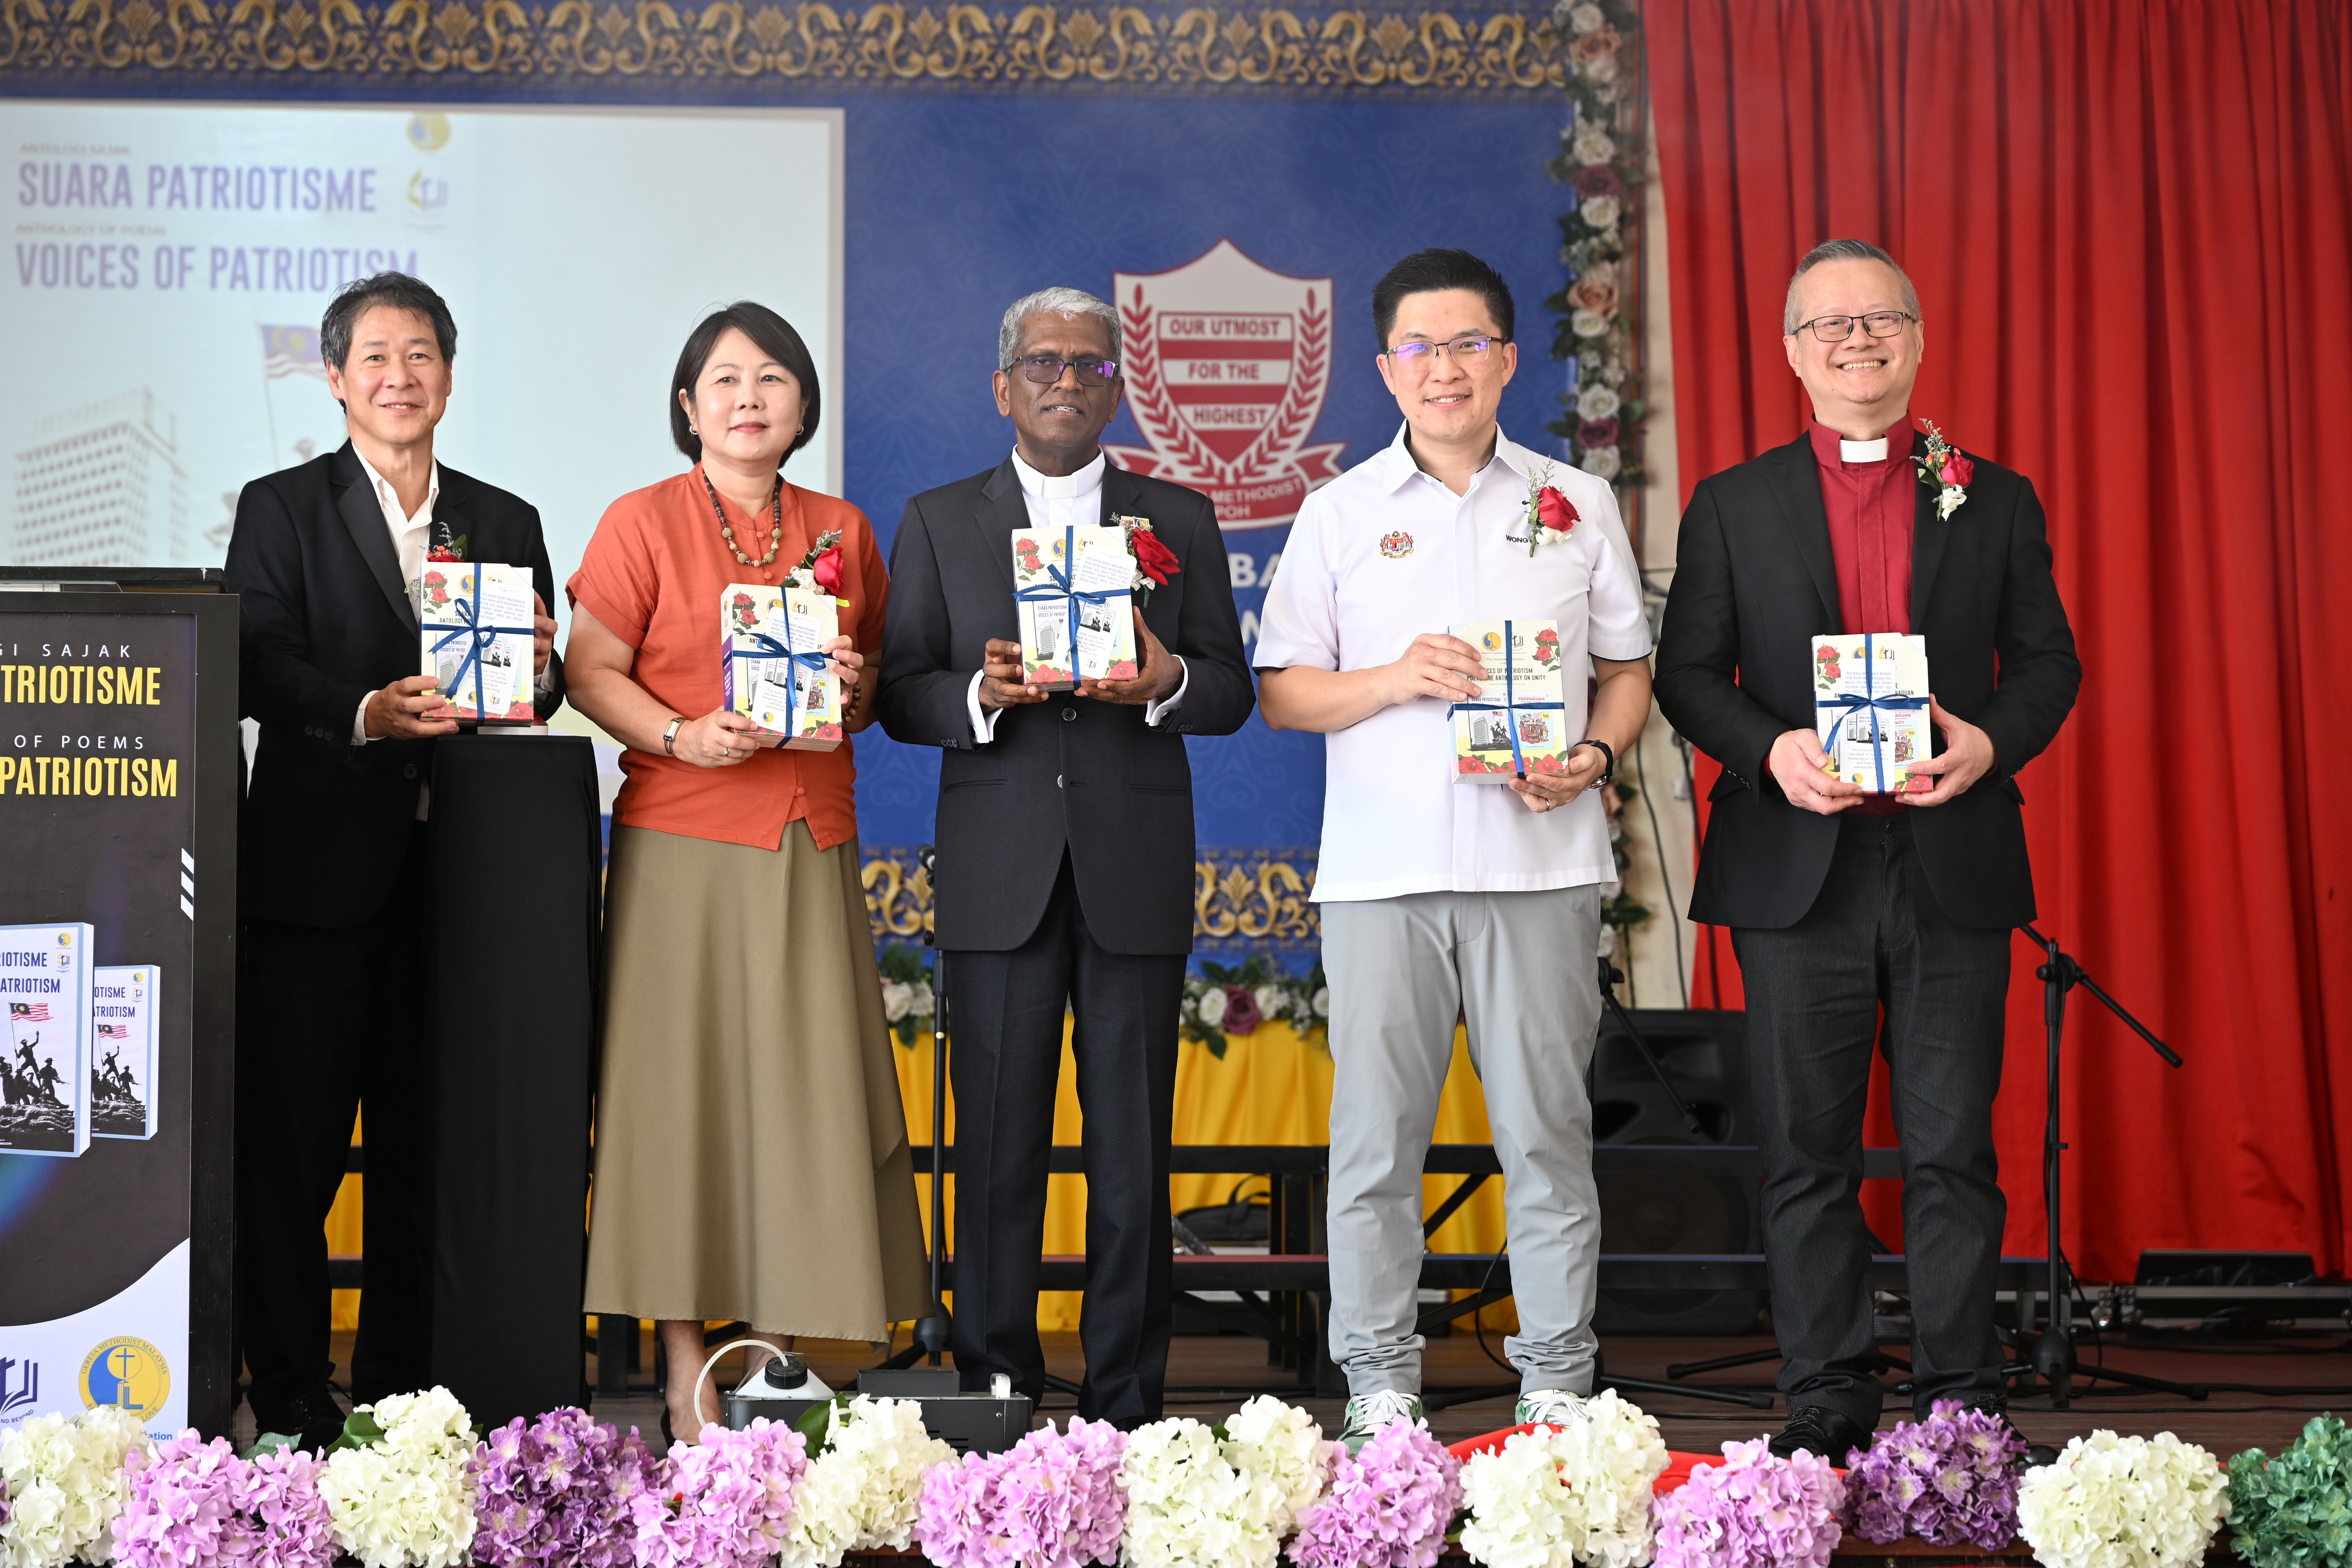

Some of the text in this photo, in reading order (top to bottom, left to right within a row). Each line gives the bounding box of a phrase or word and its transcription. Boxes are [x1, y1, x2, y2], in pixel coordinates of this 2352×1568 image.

[19, 161, 376, 211] SUARA PATRIOTISME
[16, 242, 140, 289] VOICES
[155, 246, 196, 289] OF
[1169, 319, 1279, 336] OUR UTMOST
[1188, 362, 1260, 379] FOR THE
[1194, 408, 1266, 424] HIGHEST
[1211, 477, 1302, 503] METHODIST
[1215, 505, 1251, 519] POH
[1505, 534, 1528, 543] WONG
[42, 644, 130, 658] SAJAK
[0, 665, 161, 705] TRIOTISME
[14, 735, 144, 749] OF POEMS
[0, 756, 177, 797] PATRIOTISM
[0, 978, 60, 993] ATRIOTISM
[94, 987, 126, 998] OTISME
[81, 1337, 167, 1374] GEREJA METHODIST MALAYSIA
[141, 1405, 159, 1422] LOVE
[148, 1432, 173, 1440] ation
